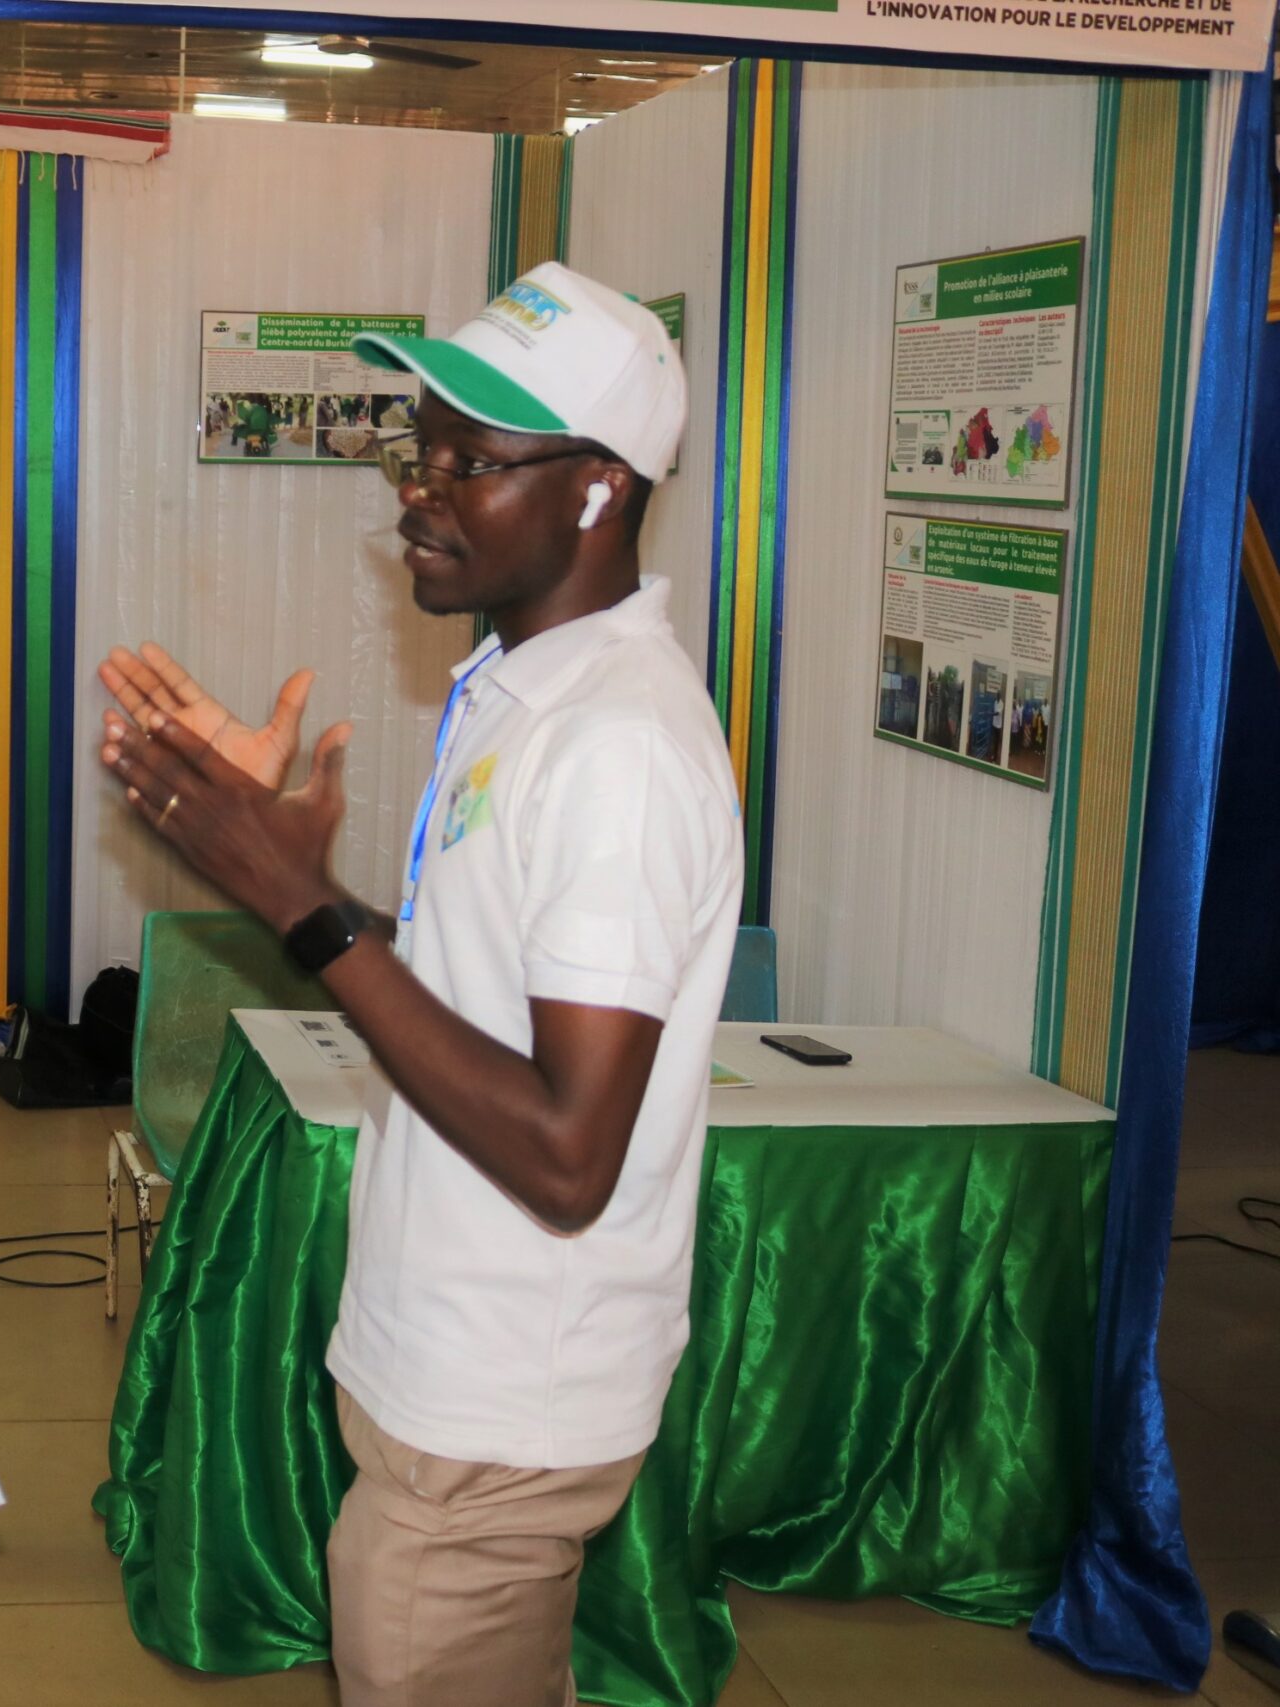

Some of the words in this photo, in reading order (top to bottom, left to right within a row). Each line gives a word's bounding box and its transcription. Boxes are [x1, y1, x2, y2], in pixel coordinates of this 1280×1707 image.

[866, 1, 996, 23] L'INNOVATION
[1001, 9, 1051, 27] POUR
[1056, 12, 1077, 28] LE
[1081, 13, 1235, 36] DEVELOPPEMENT
[944, 278, 978, 293] Promotion
[978, 276, 987, 288] de
[1025, 264, 1068, 282] plaisanterie
[973, 294, 982, 303] en
[983, 290, 1003, 303] milieu
[1004, 287, 1032, 300] scolaire
[261, 318, 324, 327] Dissémination
[330, 319, 341, 327] de
[347, 320, 355, 328] la
[361, 320, 400, 329] batteuse
[406, 321, 417, 329] de
[287, 329, 337, 338] polyvalente
[340, 329, 356, 337] dan
[261, 338, 312, 347] Centre-nord
[314, 339, 324, 347] du
[928, 525, 961, 538] Exploitation
[1000, 532, 1008, 543] de
[1043, 536, 1058, 549] base
[928, 538, 935, 547] de
[970, 542, 990, 554] locaux
[993, 547, 1008, 556] pour
[1011, 547, 1018, 557] le
